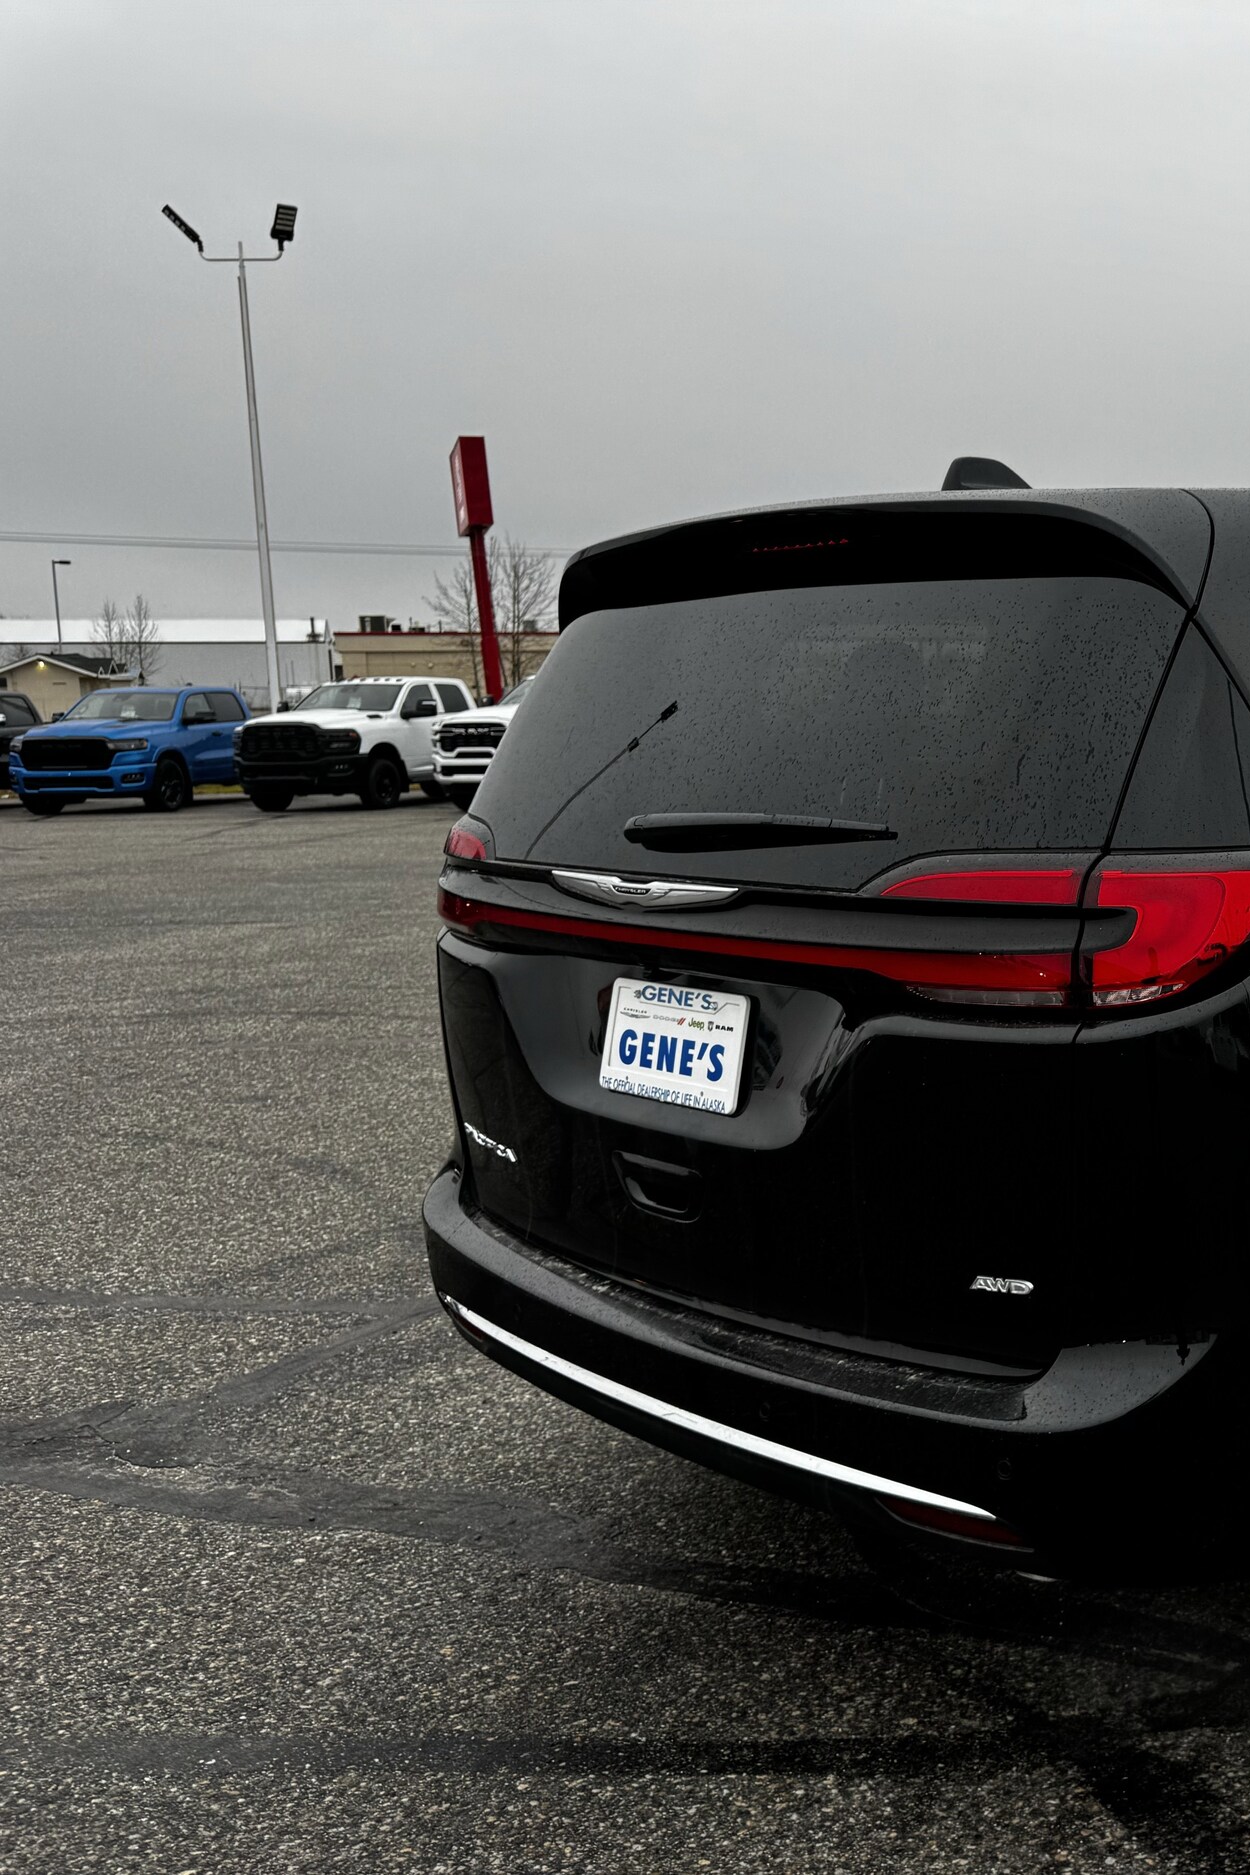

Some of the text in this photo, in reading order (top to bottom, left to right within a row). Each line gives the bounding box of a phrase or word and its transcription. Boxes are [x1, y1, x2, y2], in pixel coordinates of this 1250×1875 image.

[641, 984, 713, 1011] GENE'S
[688, 1018, 705, 1030] Jeep
[715, 1024, 734, 1032] RAM
[618, 1029, 726, 1082] GENE'S
[601, 1076, 726, 1113] THE OFFICIAL DEALERSHIP OF LIFE IN ALASKA
[969, 1275, 1034, 1295] AWD
